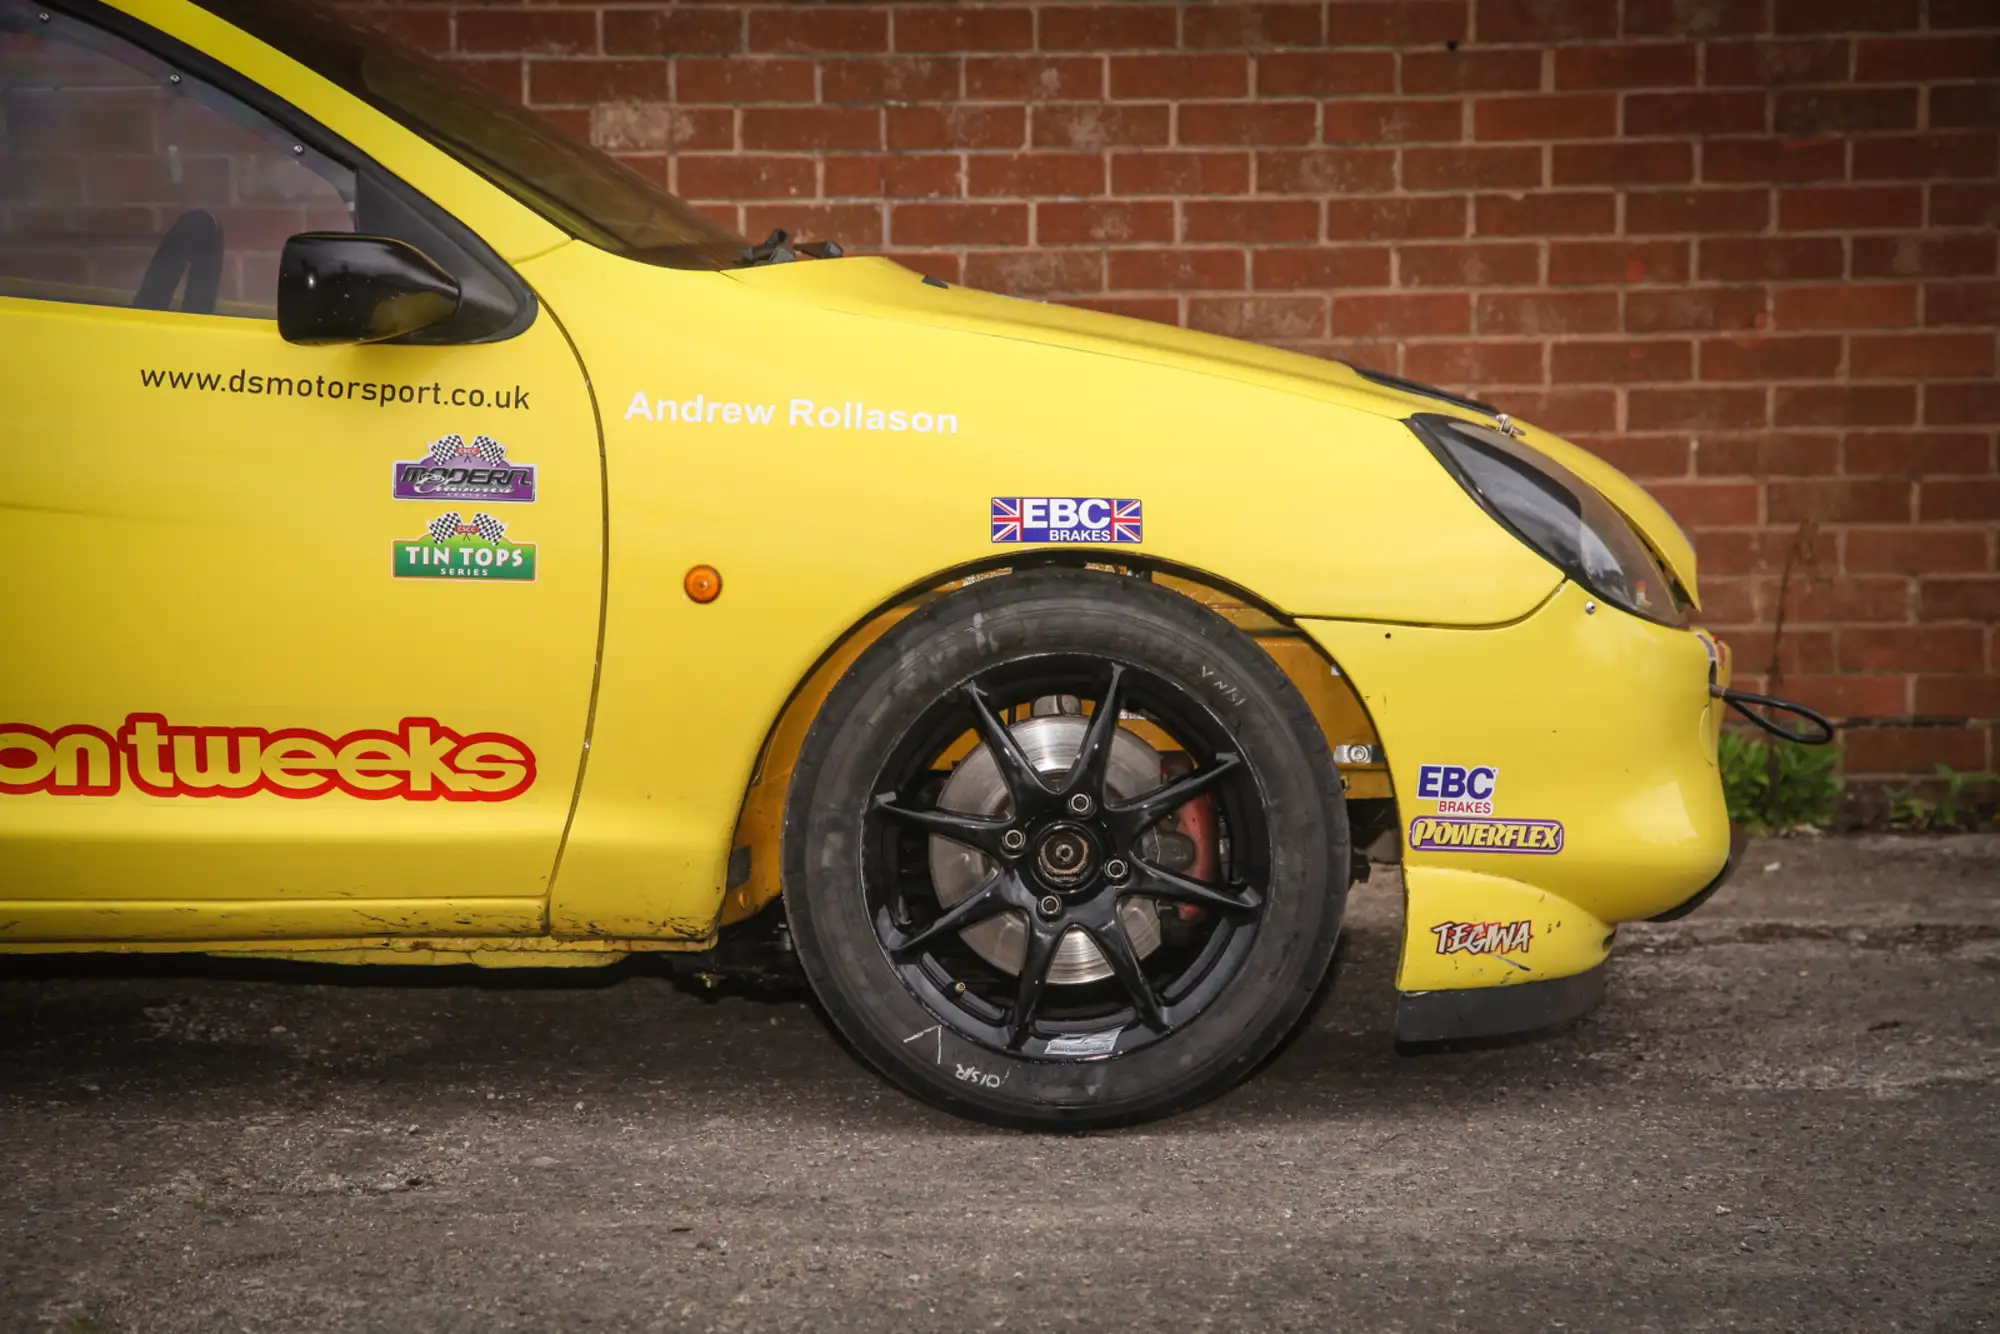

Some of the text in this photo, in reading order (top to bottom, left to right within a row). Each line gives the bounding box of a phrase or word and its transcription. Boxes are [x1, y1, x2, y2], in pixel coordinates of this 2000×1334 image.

[140, 368, 530, 410] www.dsmotorsport.co.uk
[624, 391, 957, 434] Andrew Rollason
[1023, 498, 1111, 529] EBC
[1050, 530, 1111, 541] BRAKES
[405, 546, 524, 567] TIN TOPS
[440, 568, 488, 576] SERIES
[122, 716, 533, 798] tweeks
[1418, 765, 1495, 800] EBC
[1438, 801, 1491, 814] BRAKES
[1412, 818, 1561, 849] POWERFLEX
